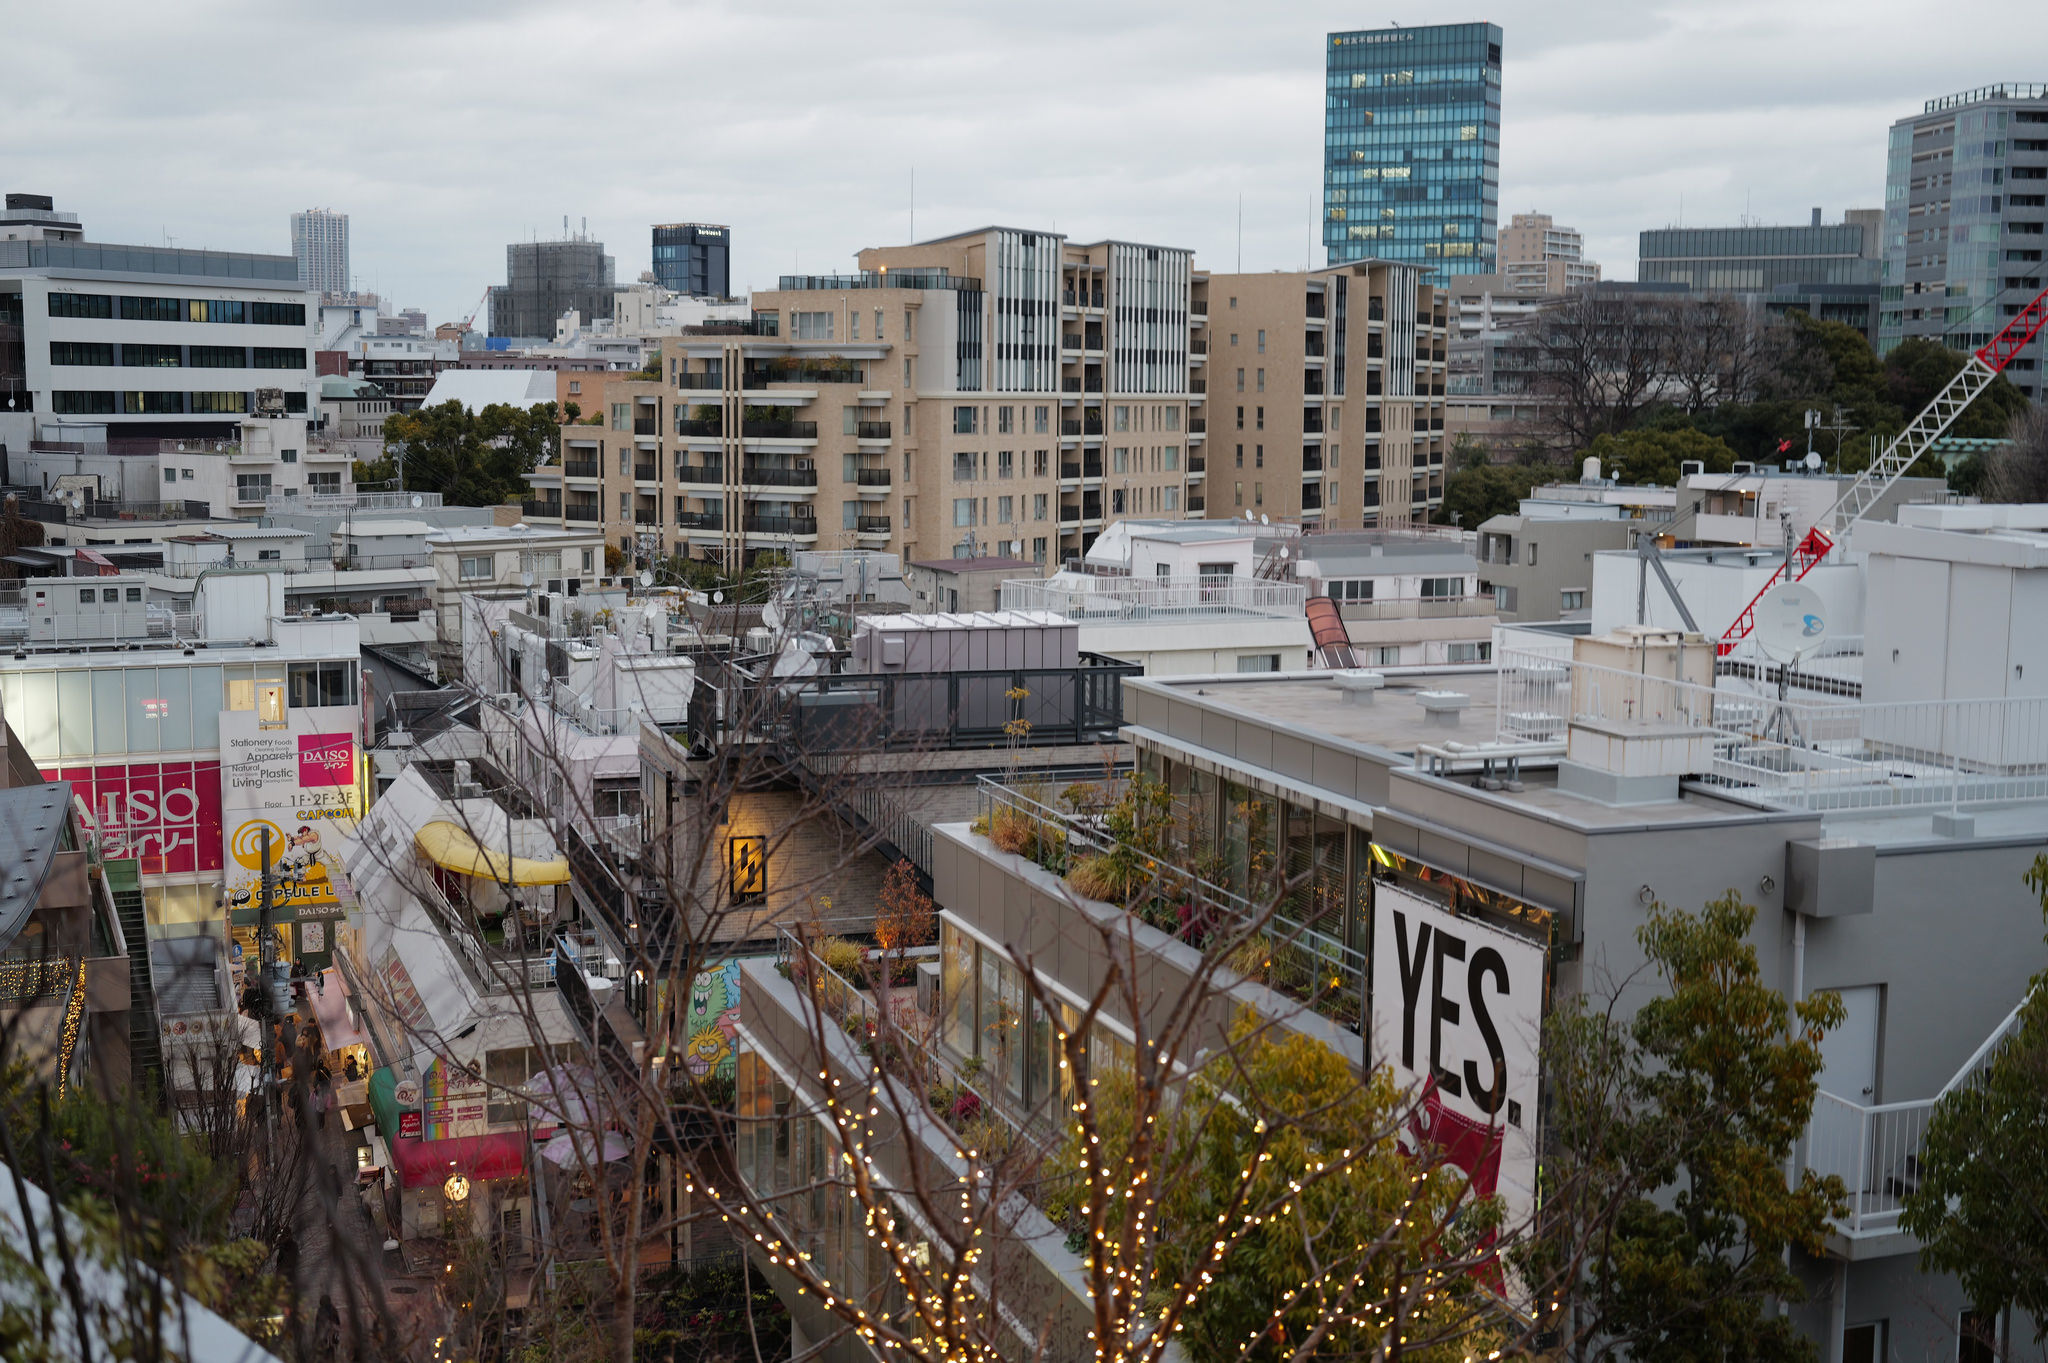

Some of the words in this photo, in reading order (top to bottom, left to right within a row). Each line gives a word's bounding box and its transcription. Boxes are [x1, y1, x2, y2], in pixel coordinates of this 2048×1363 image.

[230, 738, 273, 747] Stationery
[246, 751, 293, 763] Apparels
[302, 750, 350, 762] DAISO
[232, 764, 260, 772] Natural
[260, 768, 293, 779] Plastic
[232, 777, 262, 789] Living
[73, 787, 200, 828] AISO
[264, 801, 282, 809] Floor
[296, 808, 355, 820] CAPCOM
[256, 886, 320, 901] CPSULE
[298, 907, 328, 916] DAISO
[1392, 909, 1522, 1129] YES.
